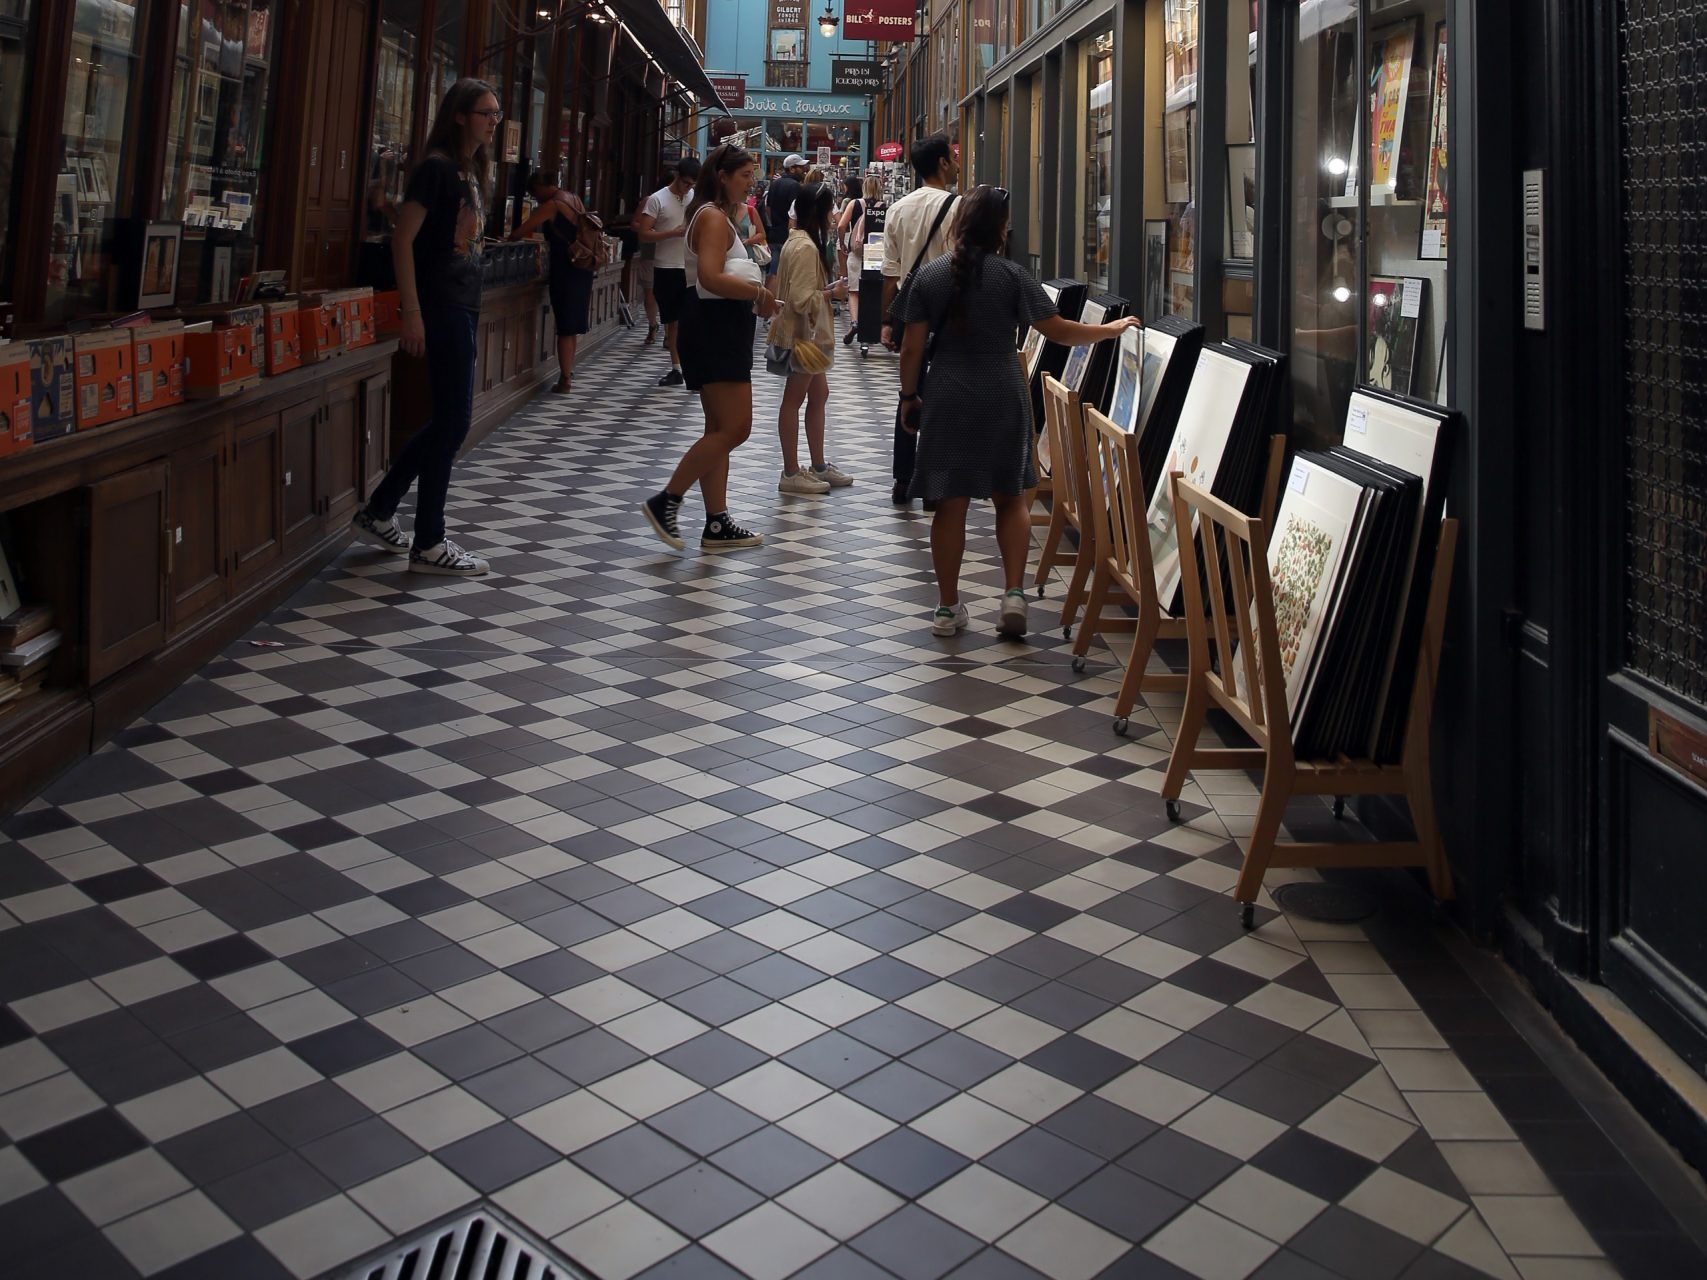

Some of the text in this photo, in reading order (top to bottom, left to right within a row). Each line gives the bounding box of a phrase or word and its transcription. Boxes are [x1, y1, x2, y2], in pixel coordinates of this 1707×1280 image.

[846, 14, 912, 26] BILL POSTERS
[844, 67, 860, 76] PARIS
[796, 97, 852, 115] Joujoux
[866, 208, 885, 217] Expo
